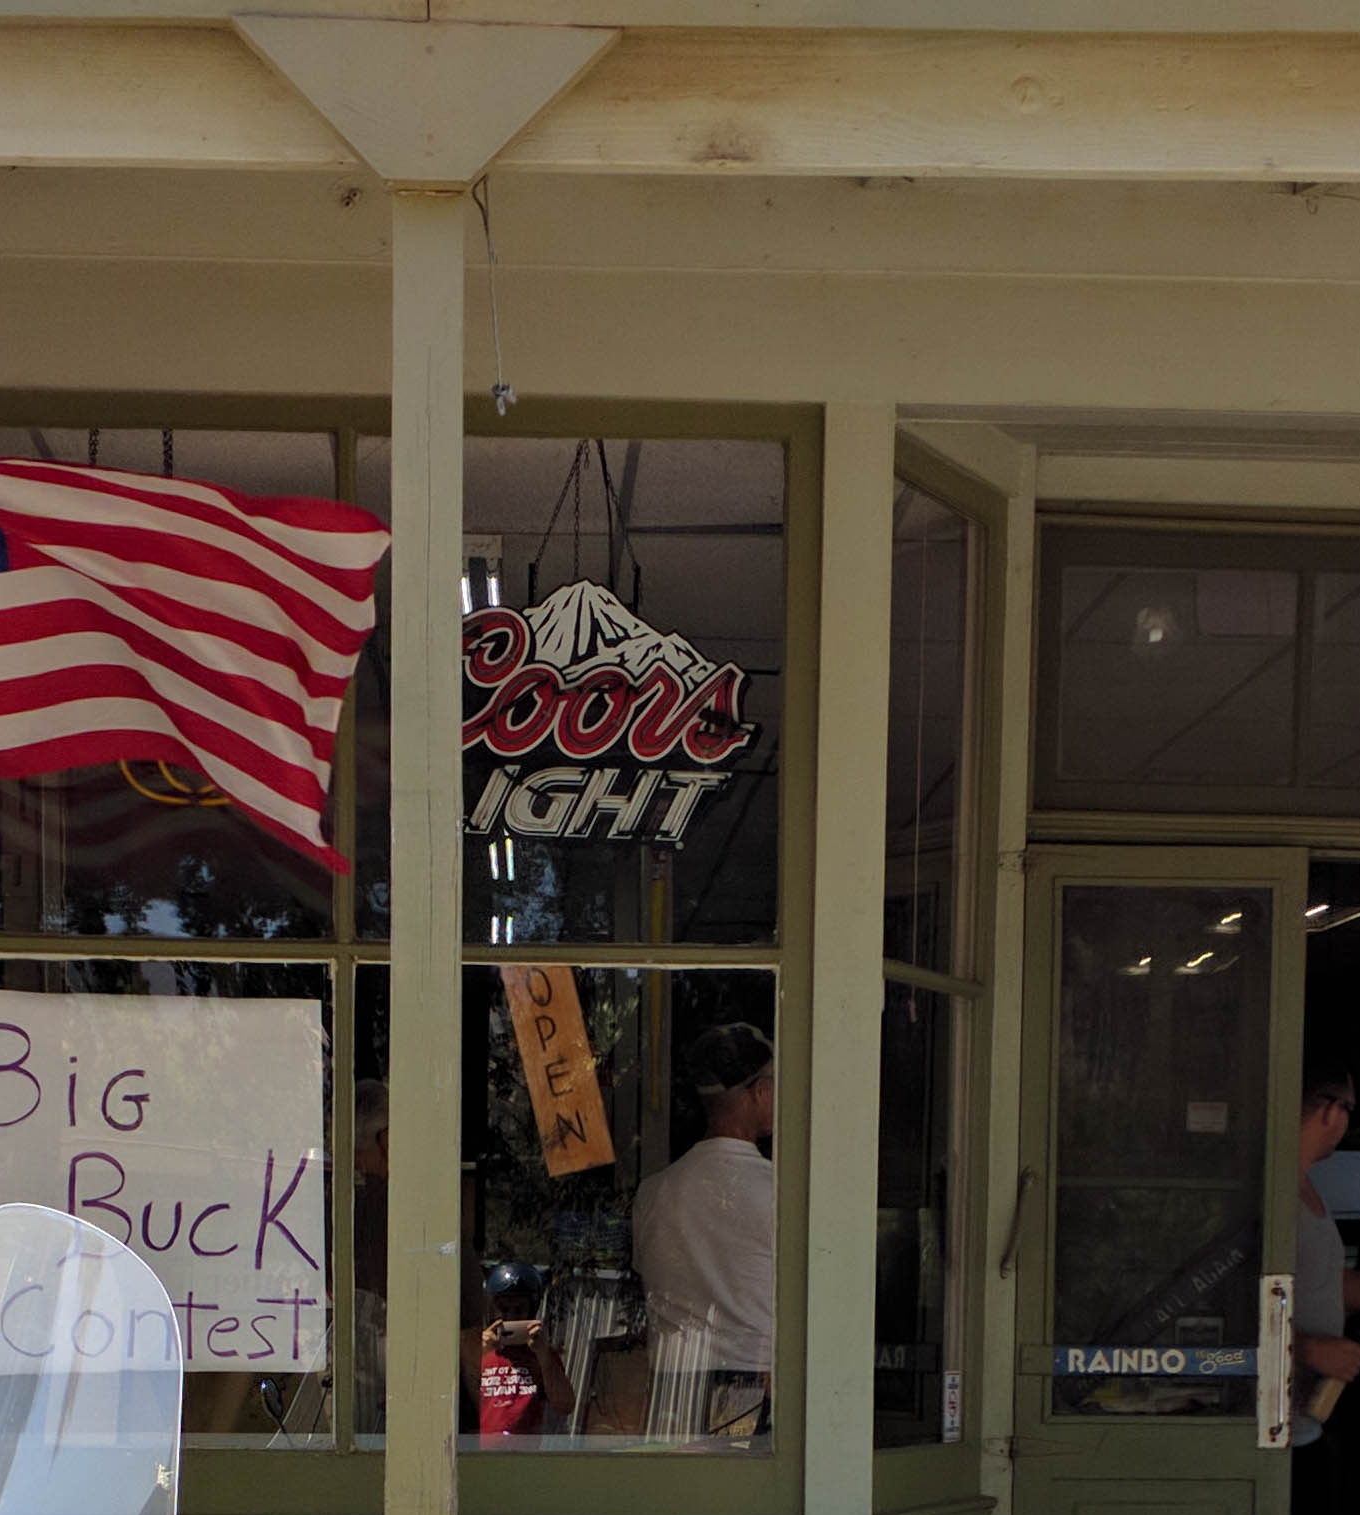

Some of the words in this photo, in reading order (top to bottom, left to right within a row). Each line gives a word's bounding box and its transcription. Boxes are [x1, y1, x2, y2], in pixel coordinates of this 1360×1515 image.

[462, 764, 732, 842] IGHT
[525, 968, 588, 1151] OPEN
[1067, 1347, 1187, 1375] RAINBO
